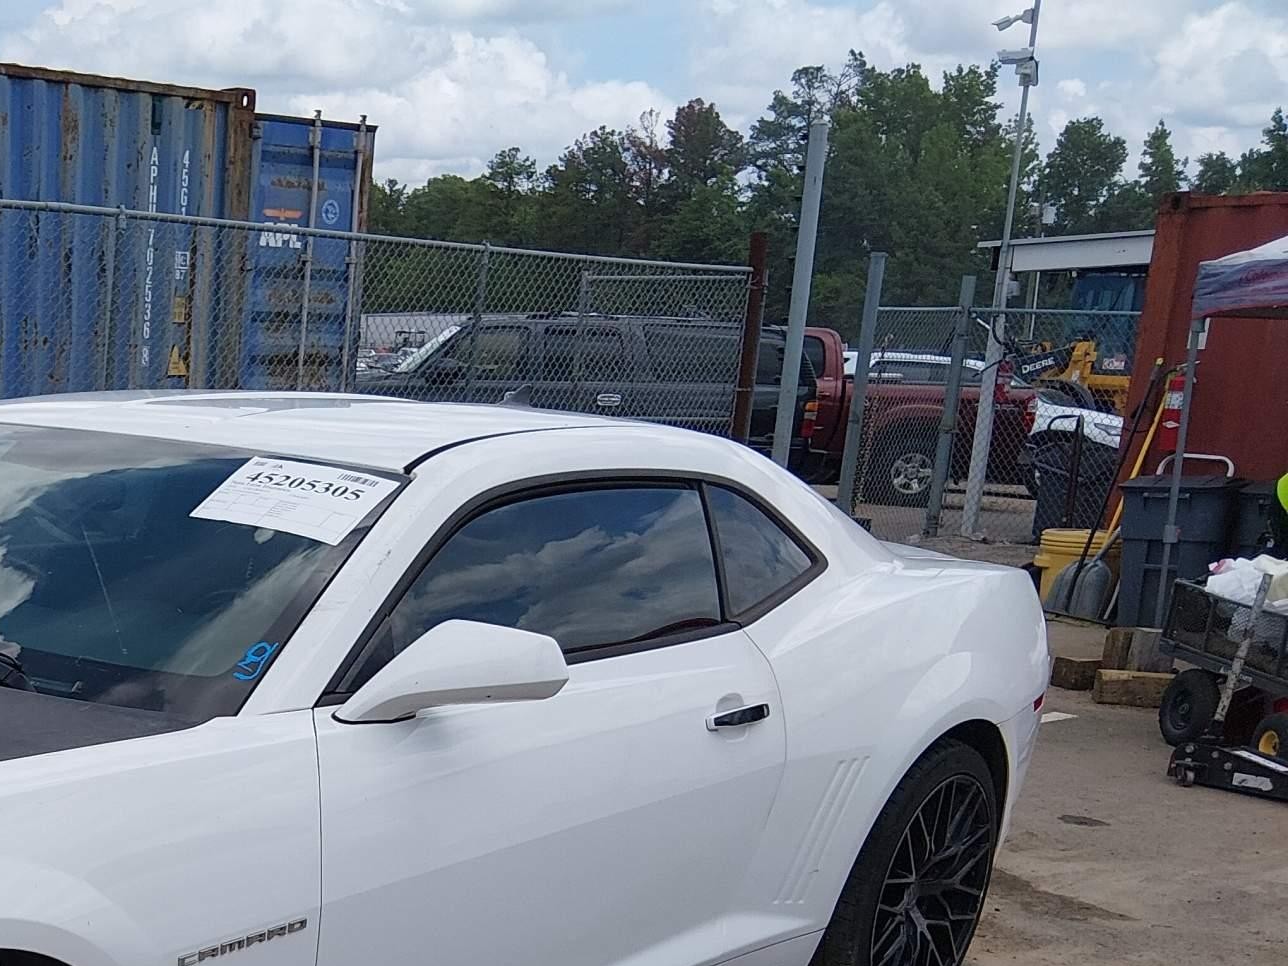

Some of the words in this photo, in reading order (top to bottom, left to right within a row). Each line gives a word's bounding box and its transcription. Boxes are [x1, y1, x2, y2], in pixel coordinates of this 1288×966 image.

[259, 222, 302, 249] APL
[143, 229, 155, 339] 702536
[1021, 356, 1056, 374] DEERE
[245, 471, 366, 502] 45205305
